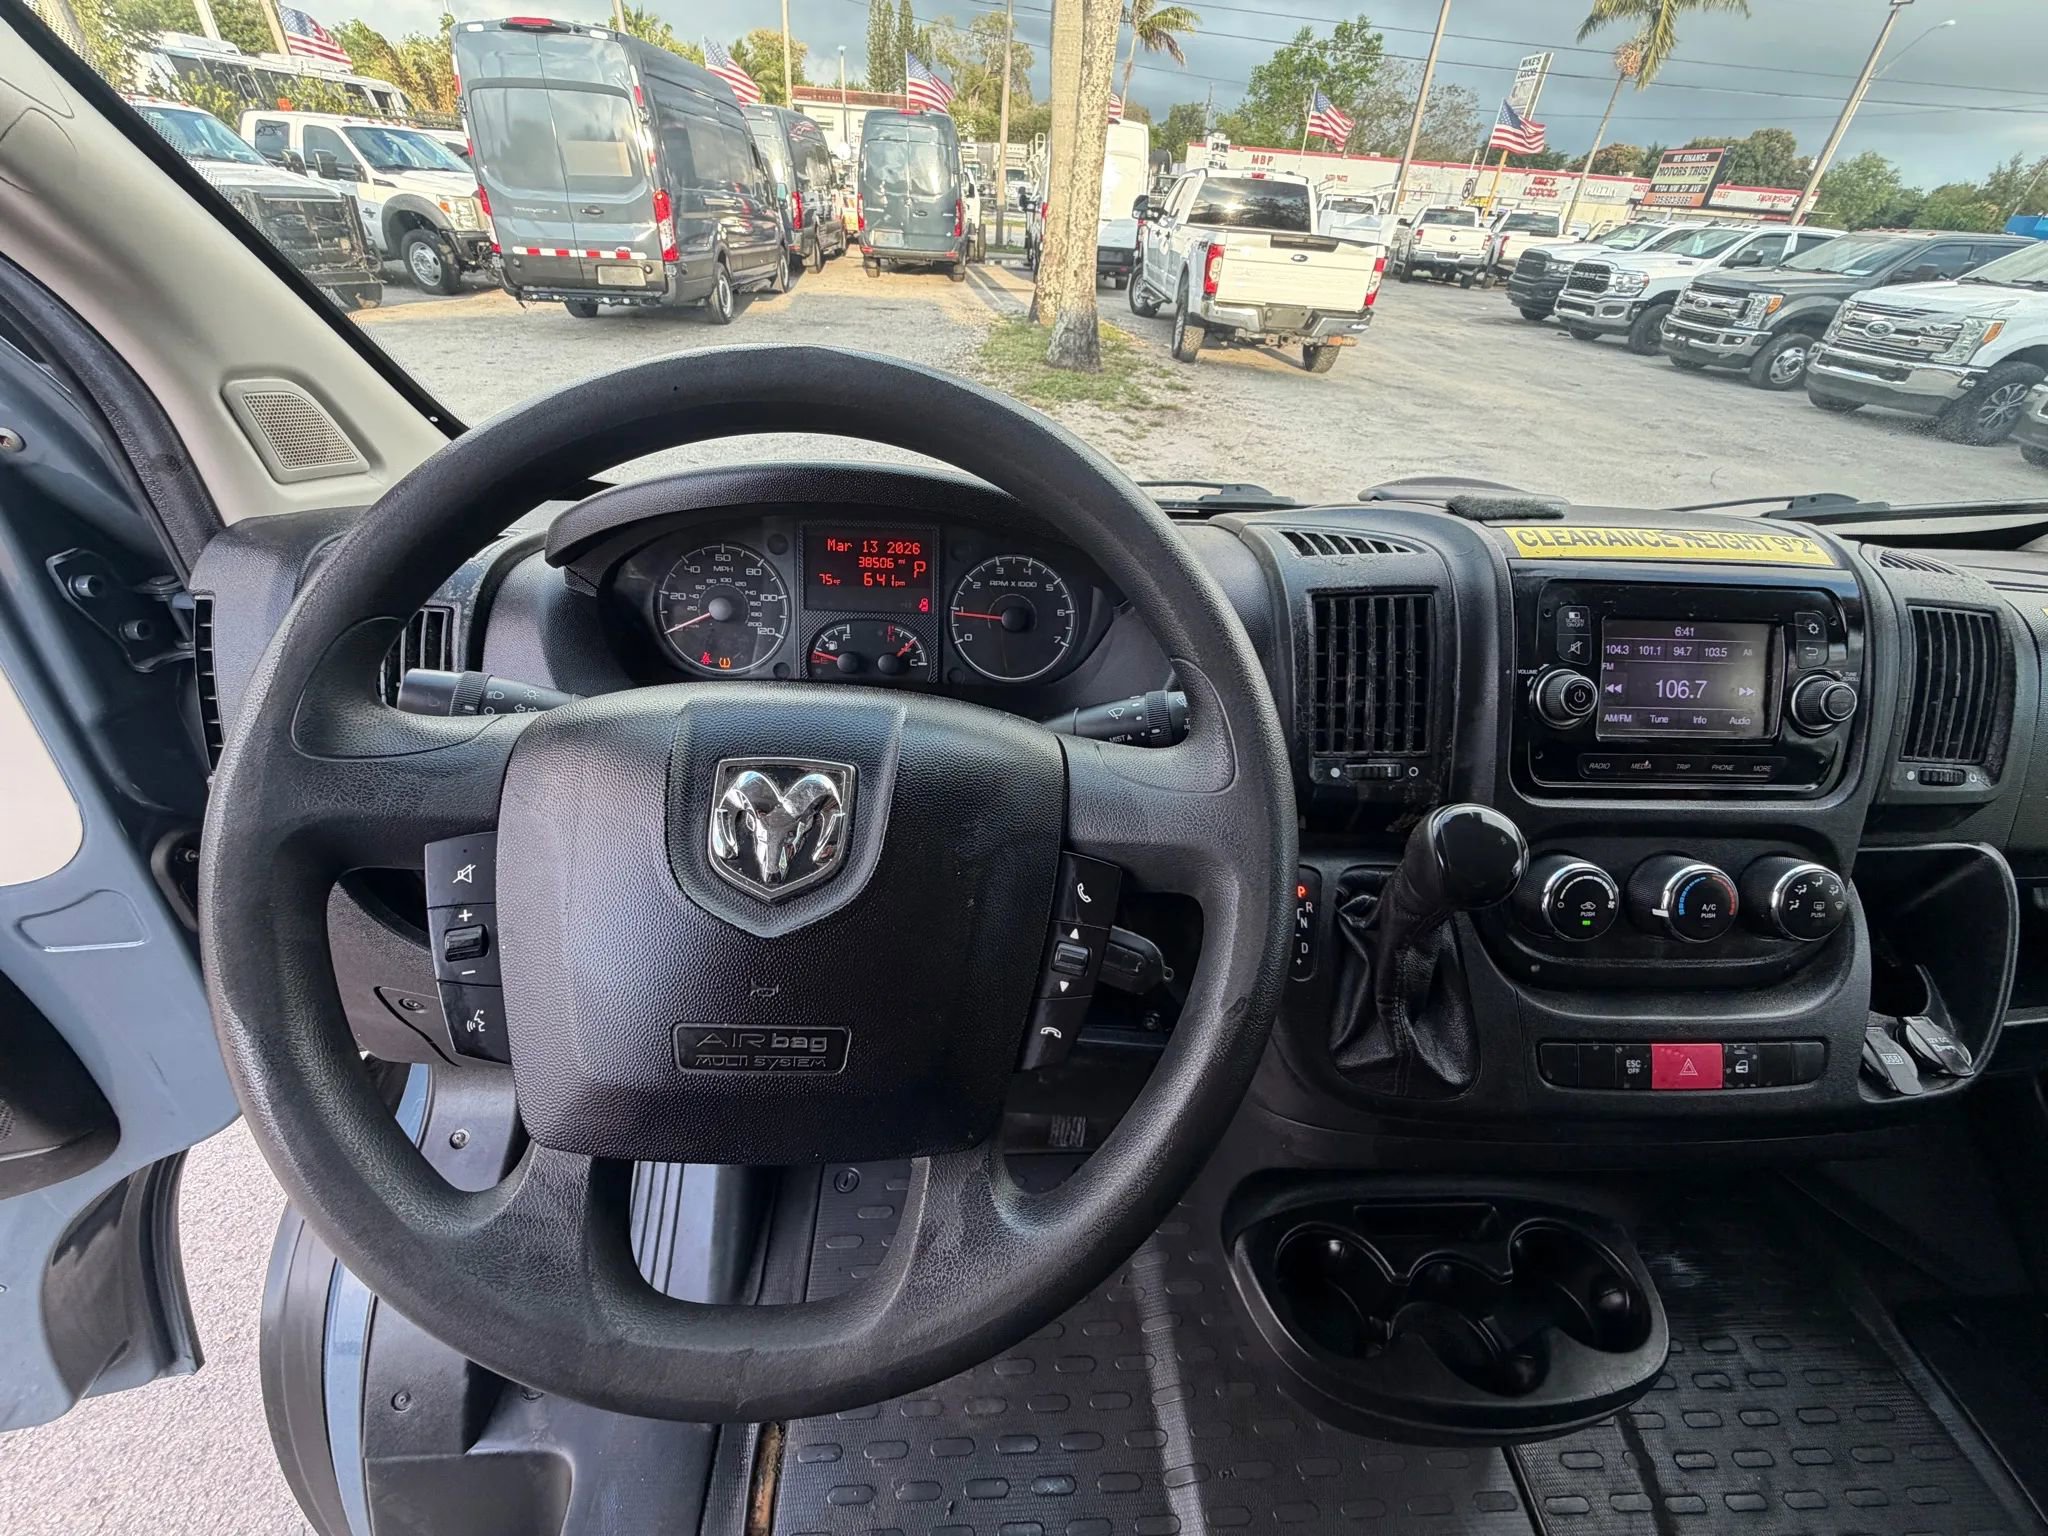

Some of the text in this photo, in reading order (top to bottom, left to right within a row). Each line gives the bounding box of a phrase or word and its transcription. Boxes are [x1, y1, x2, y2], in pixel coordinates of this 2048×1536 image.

[1657, 165, 1714, 176] MOTORS TRUST
[1515, 528, 1680, 548] CLEARANCE
[1680, 531, 1773, 551] HEIGHT
[827, 538, 921, 555] Mar 13 2026
[715, 553, 731, 562] 60
[858, 556, 895, 568] 38506
[684, 565, 700, 573] 40
[745, 568, 762, 576] 80
[913, 561, 927, 578] P
[996, 567, 1004, 575] 3
[1023, 567, 1032, 576] 4
[972, 581, 981, 589] 2
[1045, 584, 1054, 592] 5
[670, 592, 686, 600] 20
[760, 594, 778, 602] 100
[1056, 609, 1065, 617] 6
[757, 627, 776, 635] 120
[1674, 627, 1695, 637] 6:41
[964, 633, 973, 641] 0
[1053, 635, 1062, 644] 7
[1606, 645, 1630, 655] 104.3
[1639, 646, 1661, 655] 101.1
[1673, 646, 1693, 656] 94.7
[1704, 647, 1728, 657] 103.5
[1655, 679, 1708, 699] 106.7
[1603, 714, 1632, 723] AM/FM
[1649, 714, 1669, 723] Tune
[1693, 715, 1708, 724] Info
[1729, 716, 1751, 725] Audio
[1109, 735, 1127, 743] MIST
[1588, 762, 1611, 770] RADIO
[1297, 885, 1306, 898] P
[1305, 901, 1313, 913] R
[1701, 903, 1717, 912] A/C
[1300, 917, 1308, 929] N
[1301, 942, 1309, 954] D
[695, 1055, 748, 1067] MULTI
[1626, 1059, 1641, 1068] ESC
